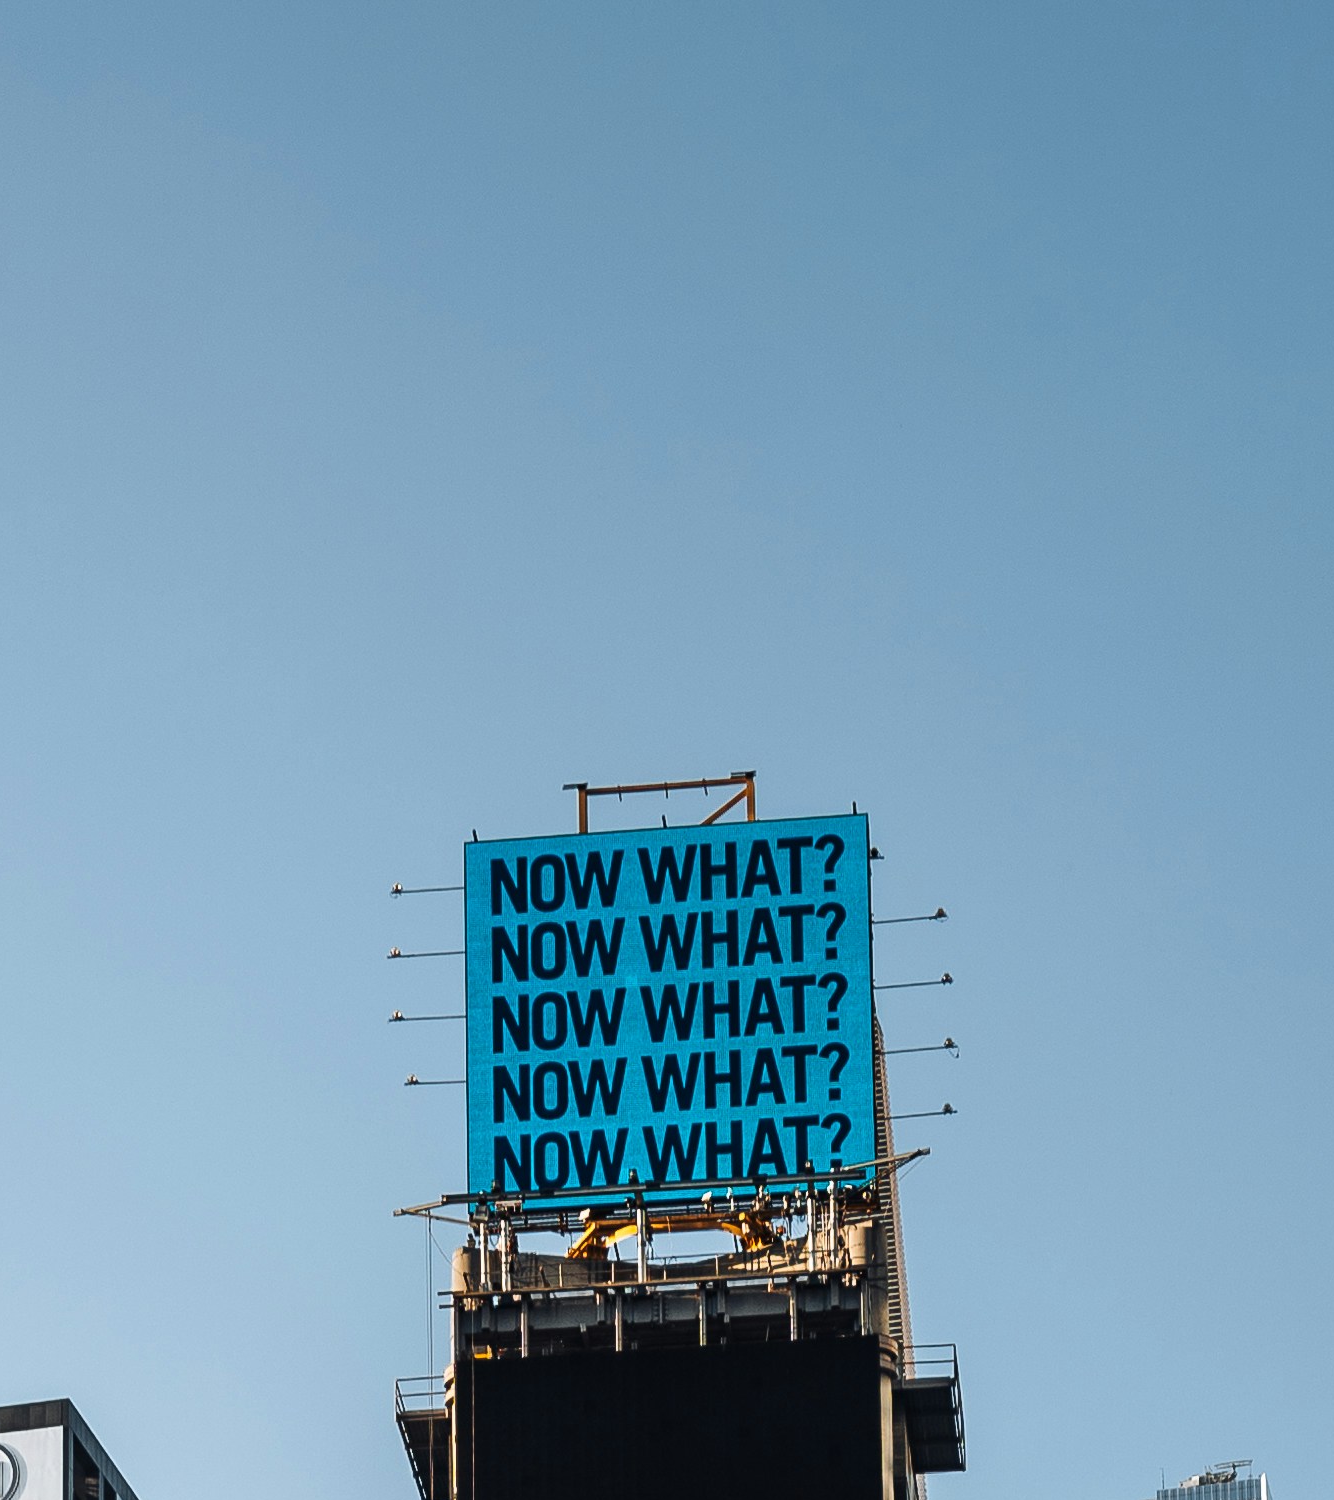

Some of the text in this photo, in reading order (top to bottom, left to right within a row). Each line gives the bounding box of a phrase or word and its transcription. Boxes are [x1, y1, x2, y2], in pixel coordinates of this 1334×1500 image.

[490, 834, 845, 916] NOW WHAT?
[491, 902, 847, 984] NOW WHAT?
[492, 972, 848, 1054] NOW WHAT?
[492, 1042, 850, 1124] NOW WHAT?
[493, 1113, 852, 1191] NOW WHAT?
